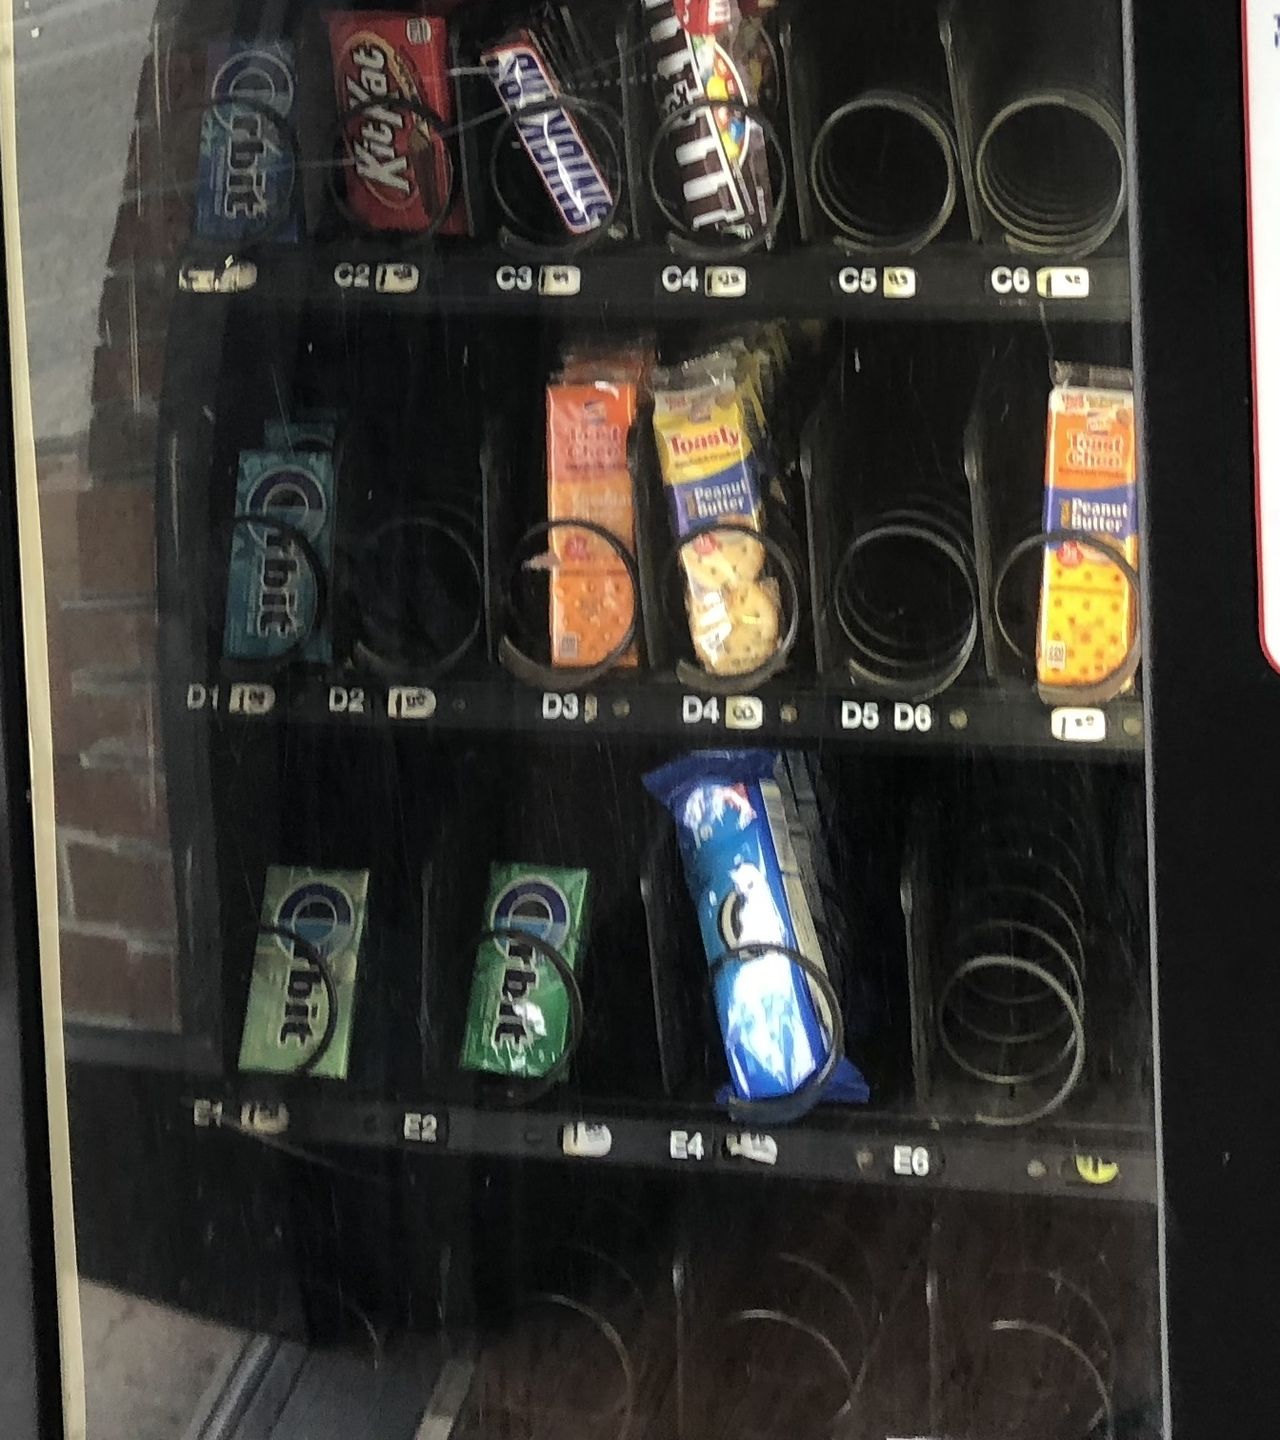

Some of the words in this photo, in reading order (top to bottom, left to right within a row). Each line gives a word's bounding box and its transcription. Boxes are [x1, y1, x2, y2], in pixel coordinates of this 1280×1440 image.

[334, 262, 370, 288] C2
[496, 265, 533, 291] C3
[662, 265, 698, 293] C4
[838, 266, 877, 293] C5
[990, 266, 1030, 293] C6
[669, 423, 740, 455] Toasty
[694, 478, 748, 500] Peanut
[697, 495, 745, 518] Butter
[1072, 497, 1128, 519] Peanut
[1071, 512, 1124, 533] Butter
[187, 683, 218, 710] D1
[329, 686, 365, 713] D2
[542, 693, 579, 720] D3
[682, 695, 720, 723] D4
[841, 701, 880, 729] D5
[894, 703, 932, 732] D6
[404, 1113, 438, 1143] E2
[670, 1129, 705, 1160] E4
[894, 1144, 929, 1177] E6
